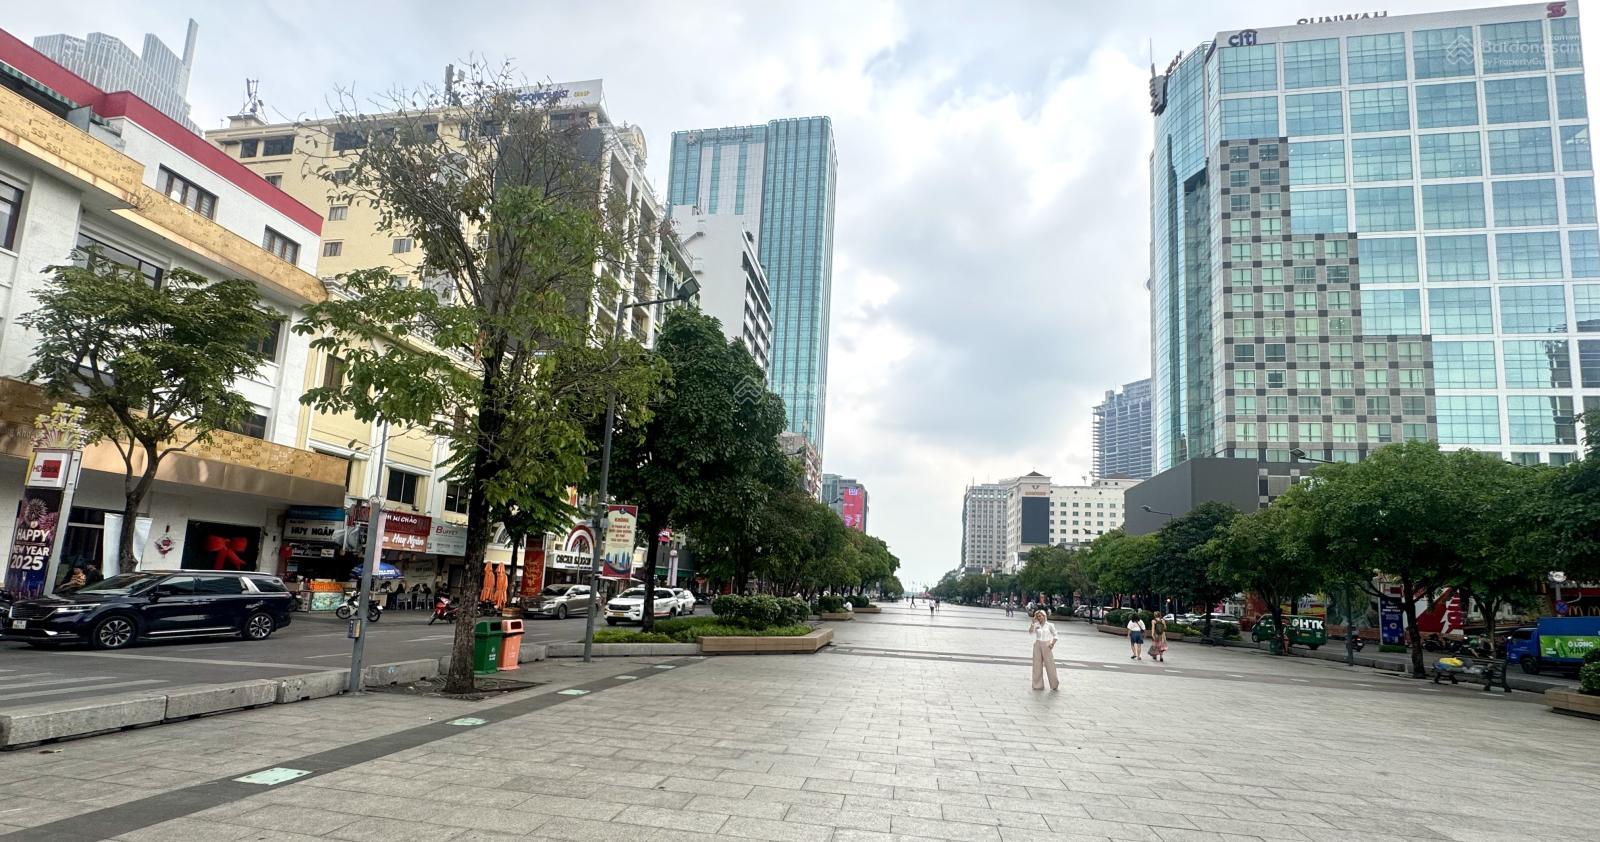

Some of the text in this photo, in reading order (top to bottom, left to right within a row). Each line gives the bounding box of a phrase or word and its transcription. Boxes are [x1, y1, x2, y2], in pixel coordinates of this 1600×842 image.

[1228, 28, 1258, 47] citi
[16, 529, 50, 542] HAPPY
[290, 526, 309, 536] HUY
[12, 545, 50, 556] NEW YEAR
[10, 554, 44, 571] 2025
